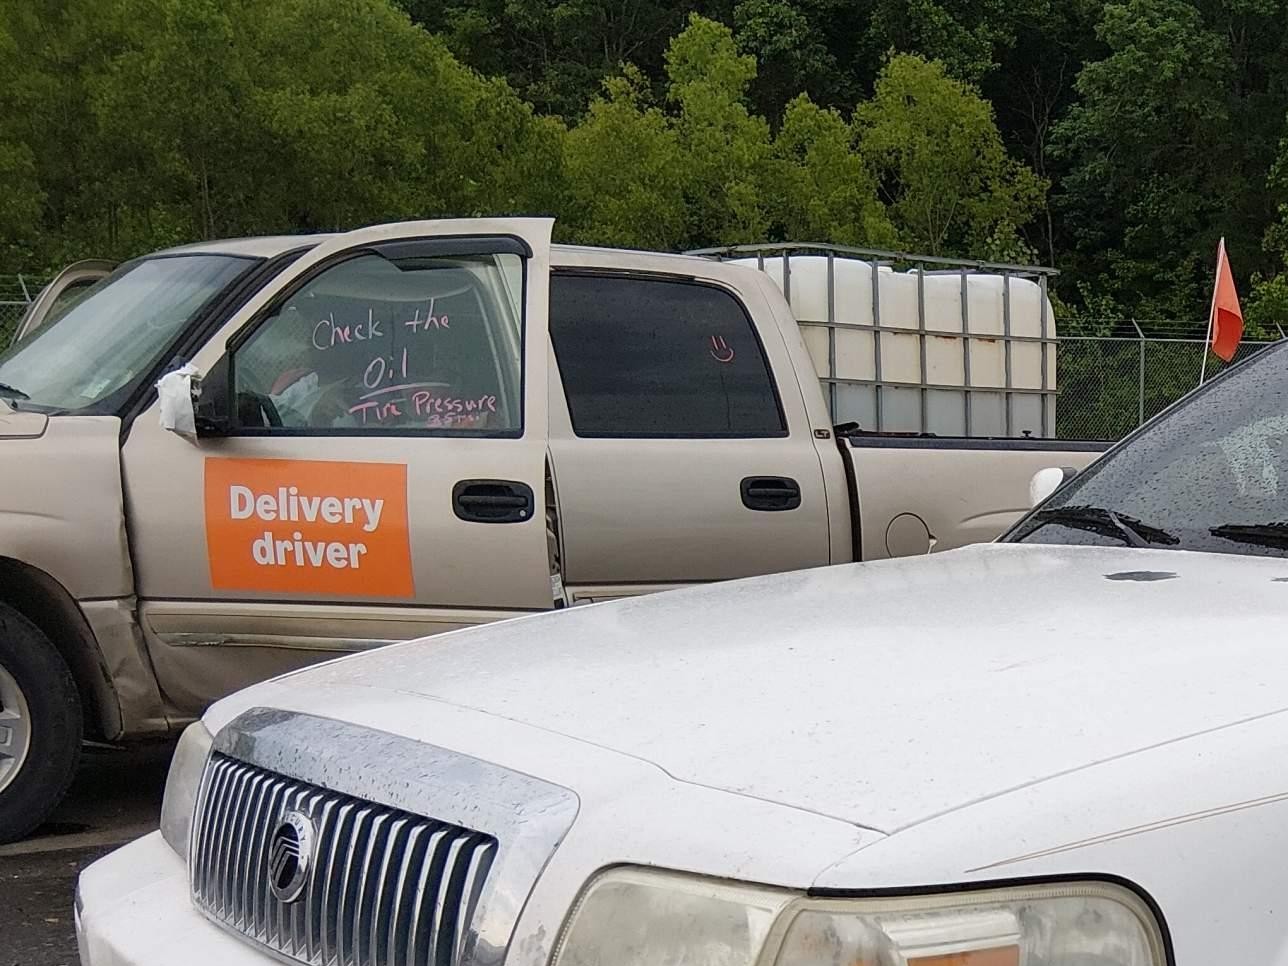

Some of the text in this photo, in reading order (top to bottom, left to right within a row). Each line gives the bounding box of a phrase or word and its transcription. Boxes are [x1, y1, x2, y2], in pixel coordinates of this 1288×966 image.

[312, 298, 449, 350] Check the
[363, 347, 408, 389] Oil
[349, 390, 496, 424] Tire Pressure
[815, 430, 830, 438] LT
[230, 485, 384, 532] Delivery
[252, 531, 367, 569] driver
